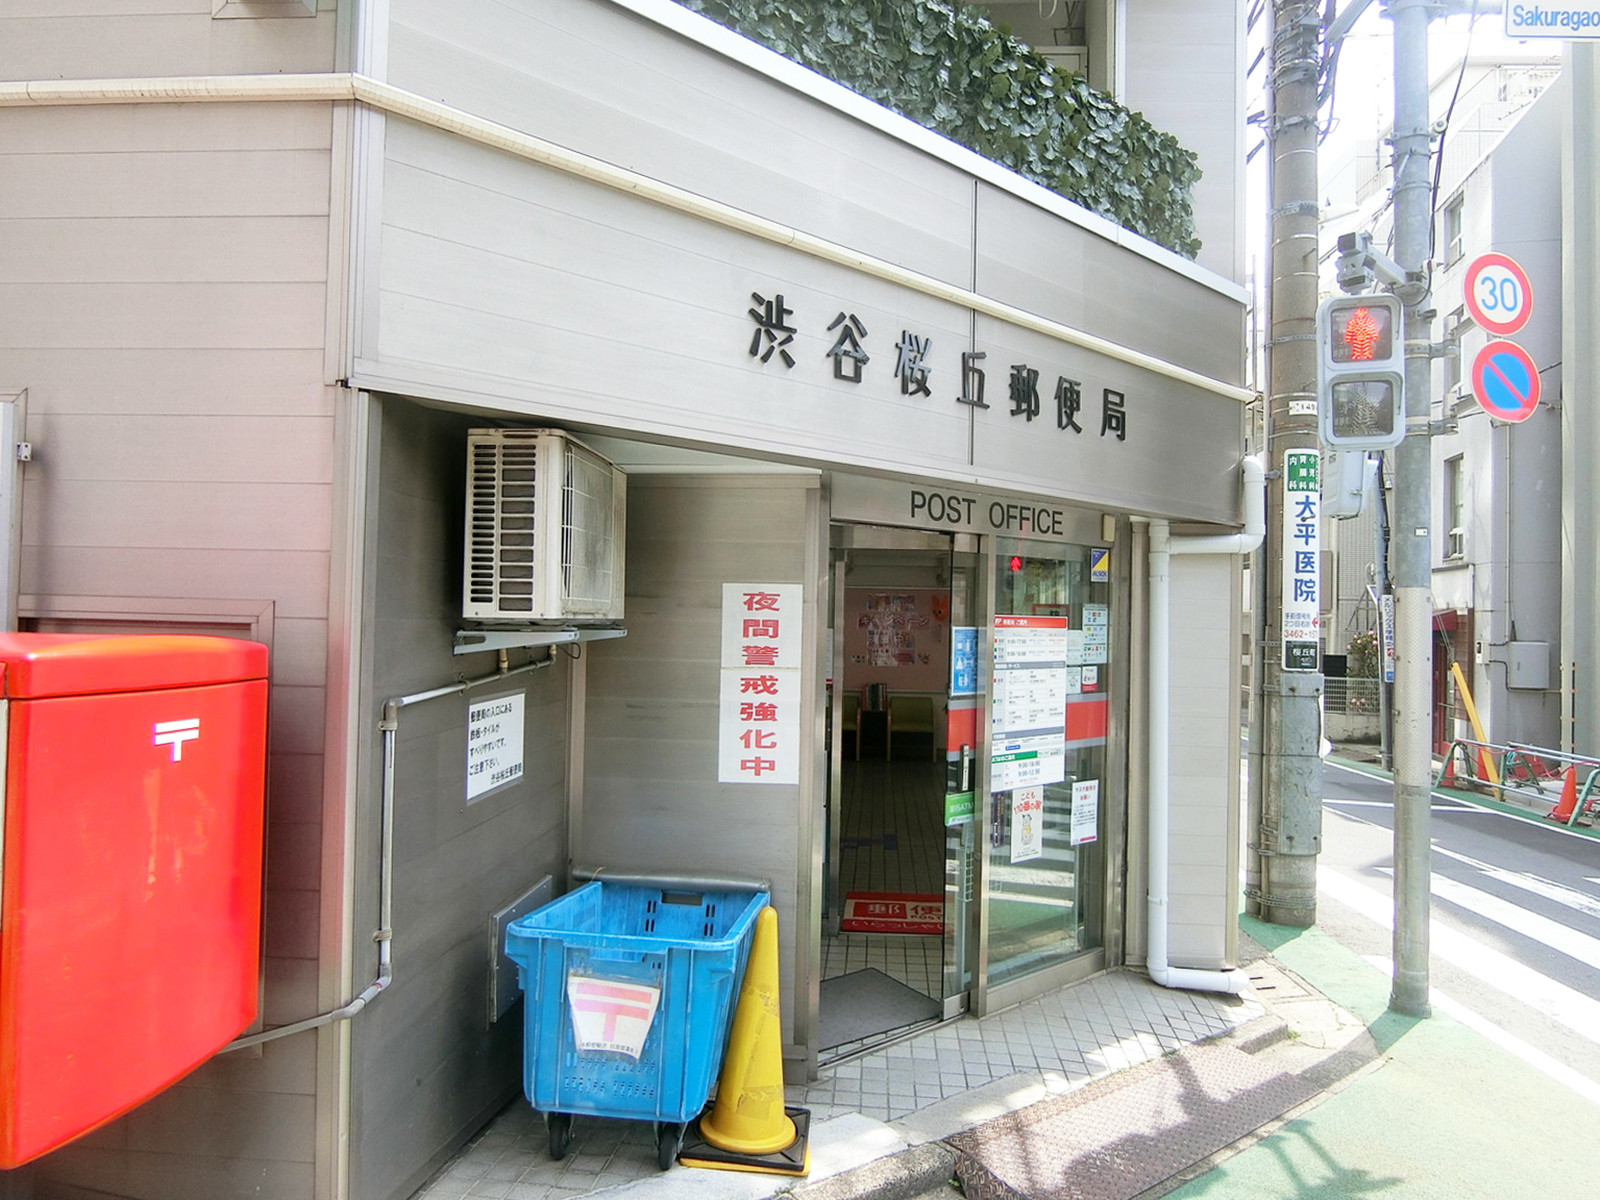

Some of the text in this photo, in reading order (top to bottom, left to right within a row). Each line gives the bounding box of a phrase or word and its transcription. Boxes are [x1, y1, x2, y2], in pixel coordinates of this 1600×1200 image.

[1513, 4, 1600, 31] Sakuragao
[1480, 276, 1518, 312] 30
[747, 292, 1127, 442] 渋谷桜丘郵便局
[1289, 456, 1298, 490] 内科
[910, 490, 1063, 536] POST OFFICE
[1293, 494, 1317, 602] 大平医院
[739, 591, 781, 777] 夜間警戒強化中
[1020, 791, 1036, 801] こども
